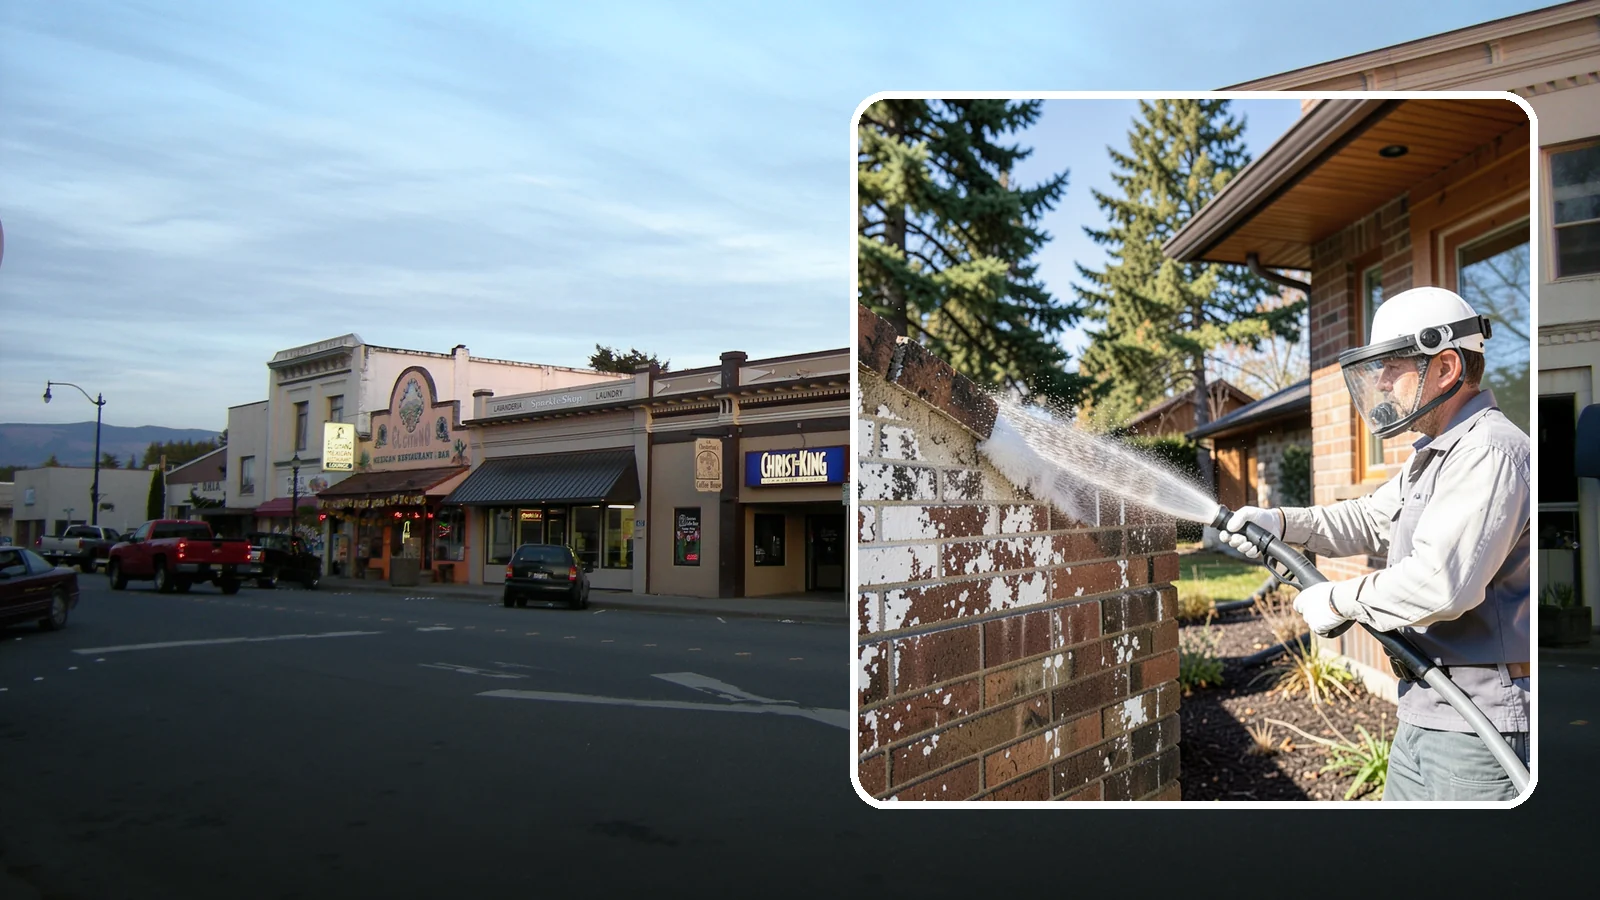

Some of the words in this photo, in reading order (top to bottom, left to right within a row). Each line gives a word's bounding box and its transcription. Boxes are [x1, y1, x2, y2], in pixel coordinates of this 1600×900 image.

[493, 402, 523, 413] LAVANDERIA
[530, 397, 560, 409] Sparkle
[562, 394, 583, 404] Shop
[595, 388, 624, 400] LAUNDRY
[373, 454, 396, 464] MEXICAN
[397, 451, 433, 463] RESTAURANT
[438, 450, 450, 459] BAR
[761, 452, 797, 478] CHRIST
[799, 450, 827, 476] KING
[697, 480, 709, 489] Coffee
[710, 480, 722, 489] House
